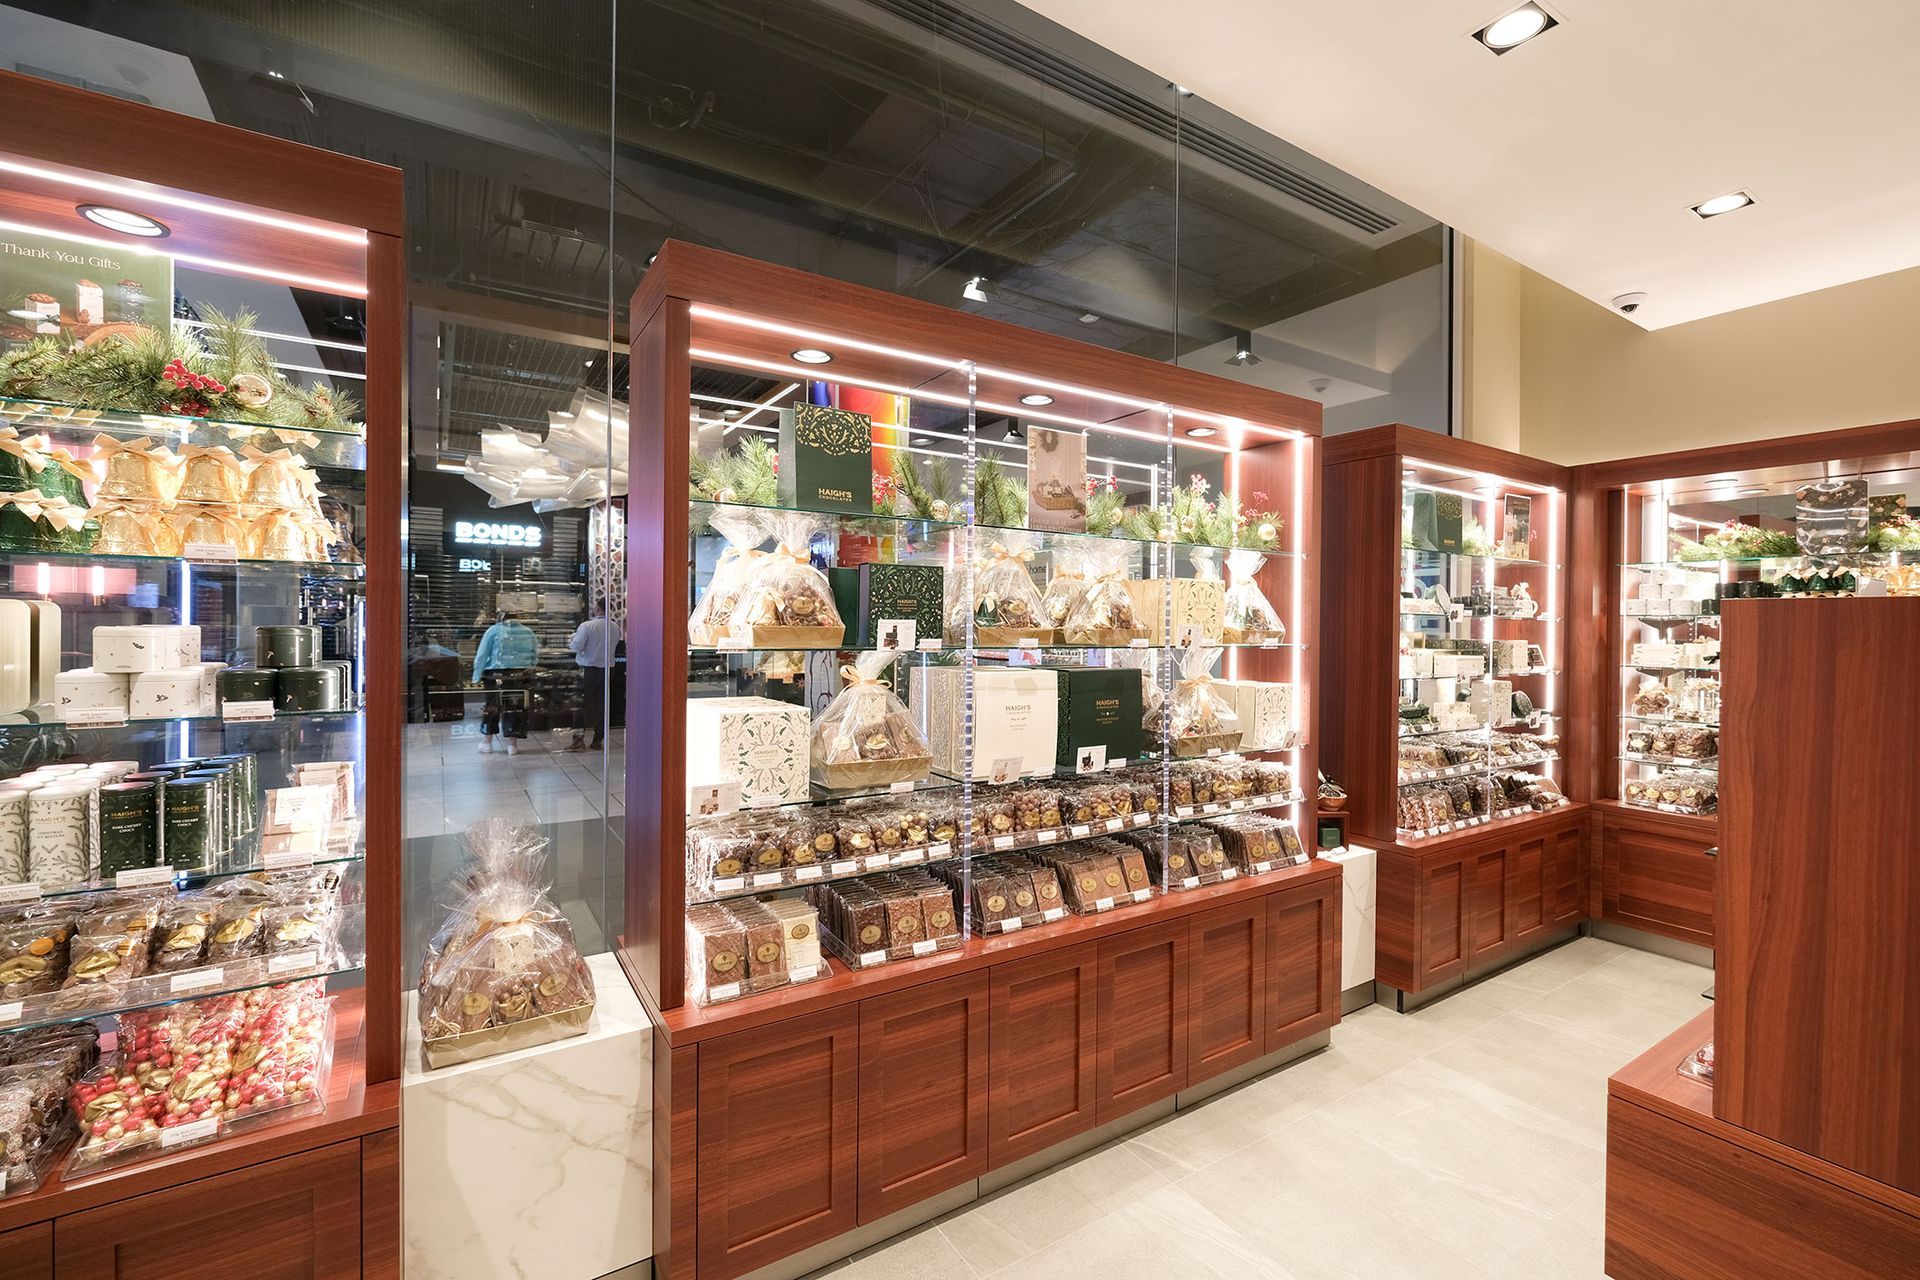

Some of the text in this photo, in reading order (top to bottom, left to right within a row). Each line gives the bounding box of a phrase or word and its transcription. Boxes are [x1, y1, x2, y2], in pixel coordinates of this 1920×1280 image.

[1, 242, 121, 270] Thank You Gifts
[818, 488, 852, 498] HAIGH'S
[455, 521, 542, 543] BONDS
[111, 810, 143, 818] HAIGH'S
